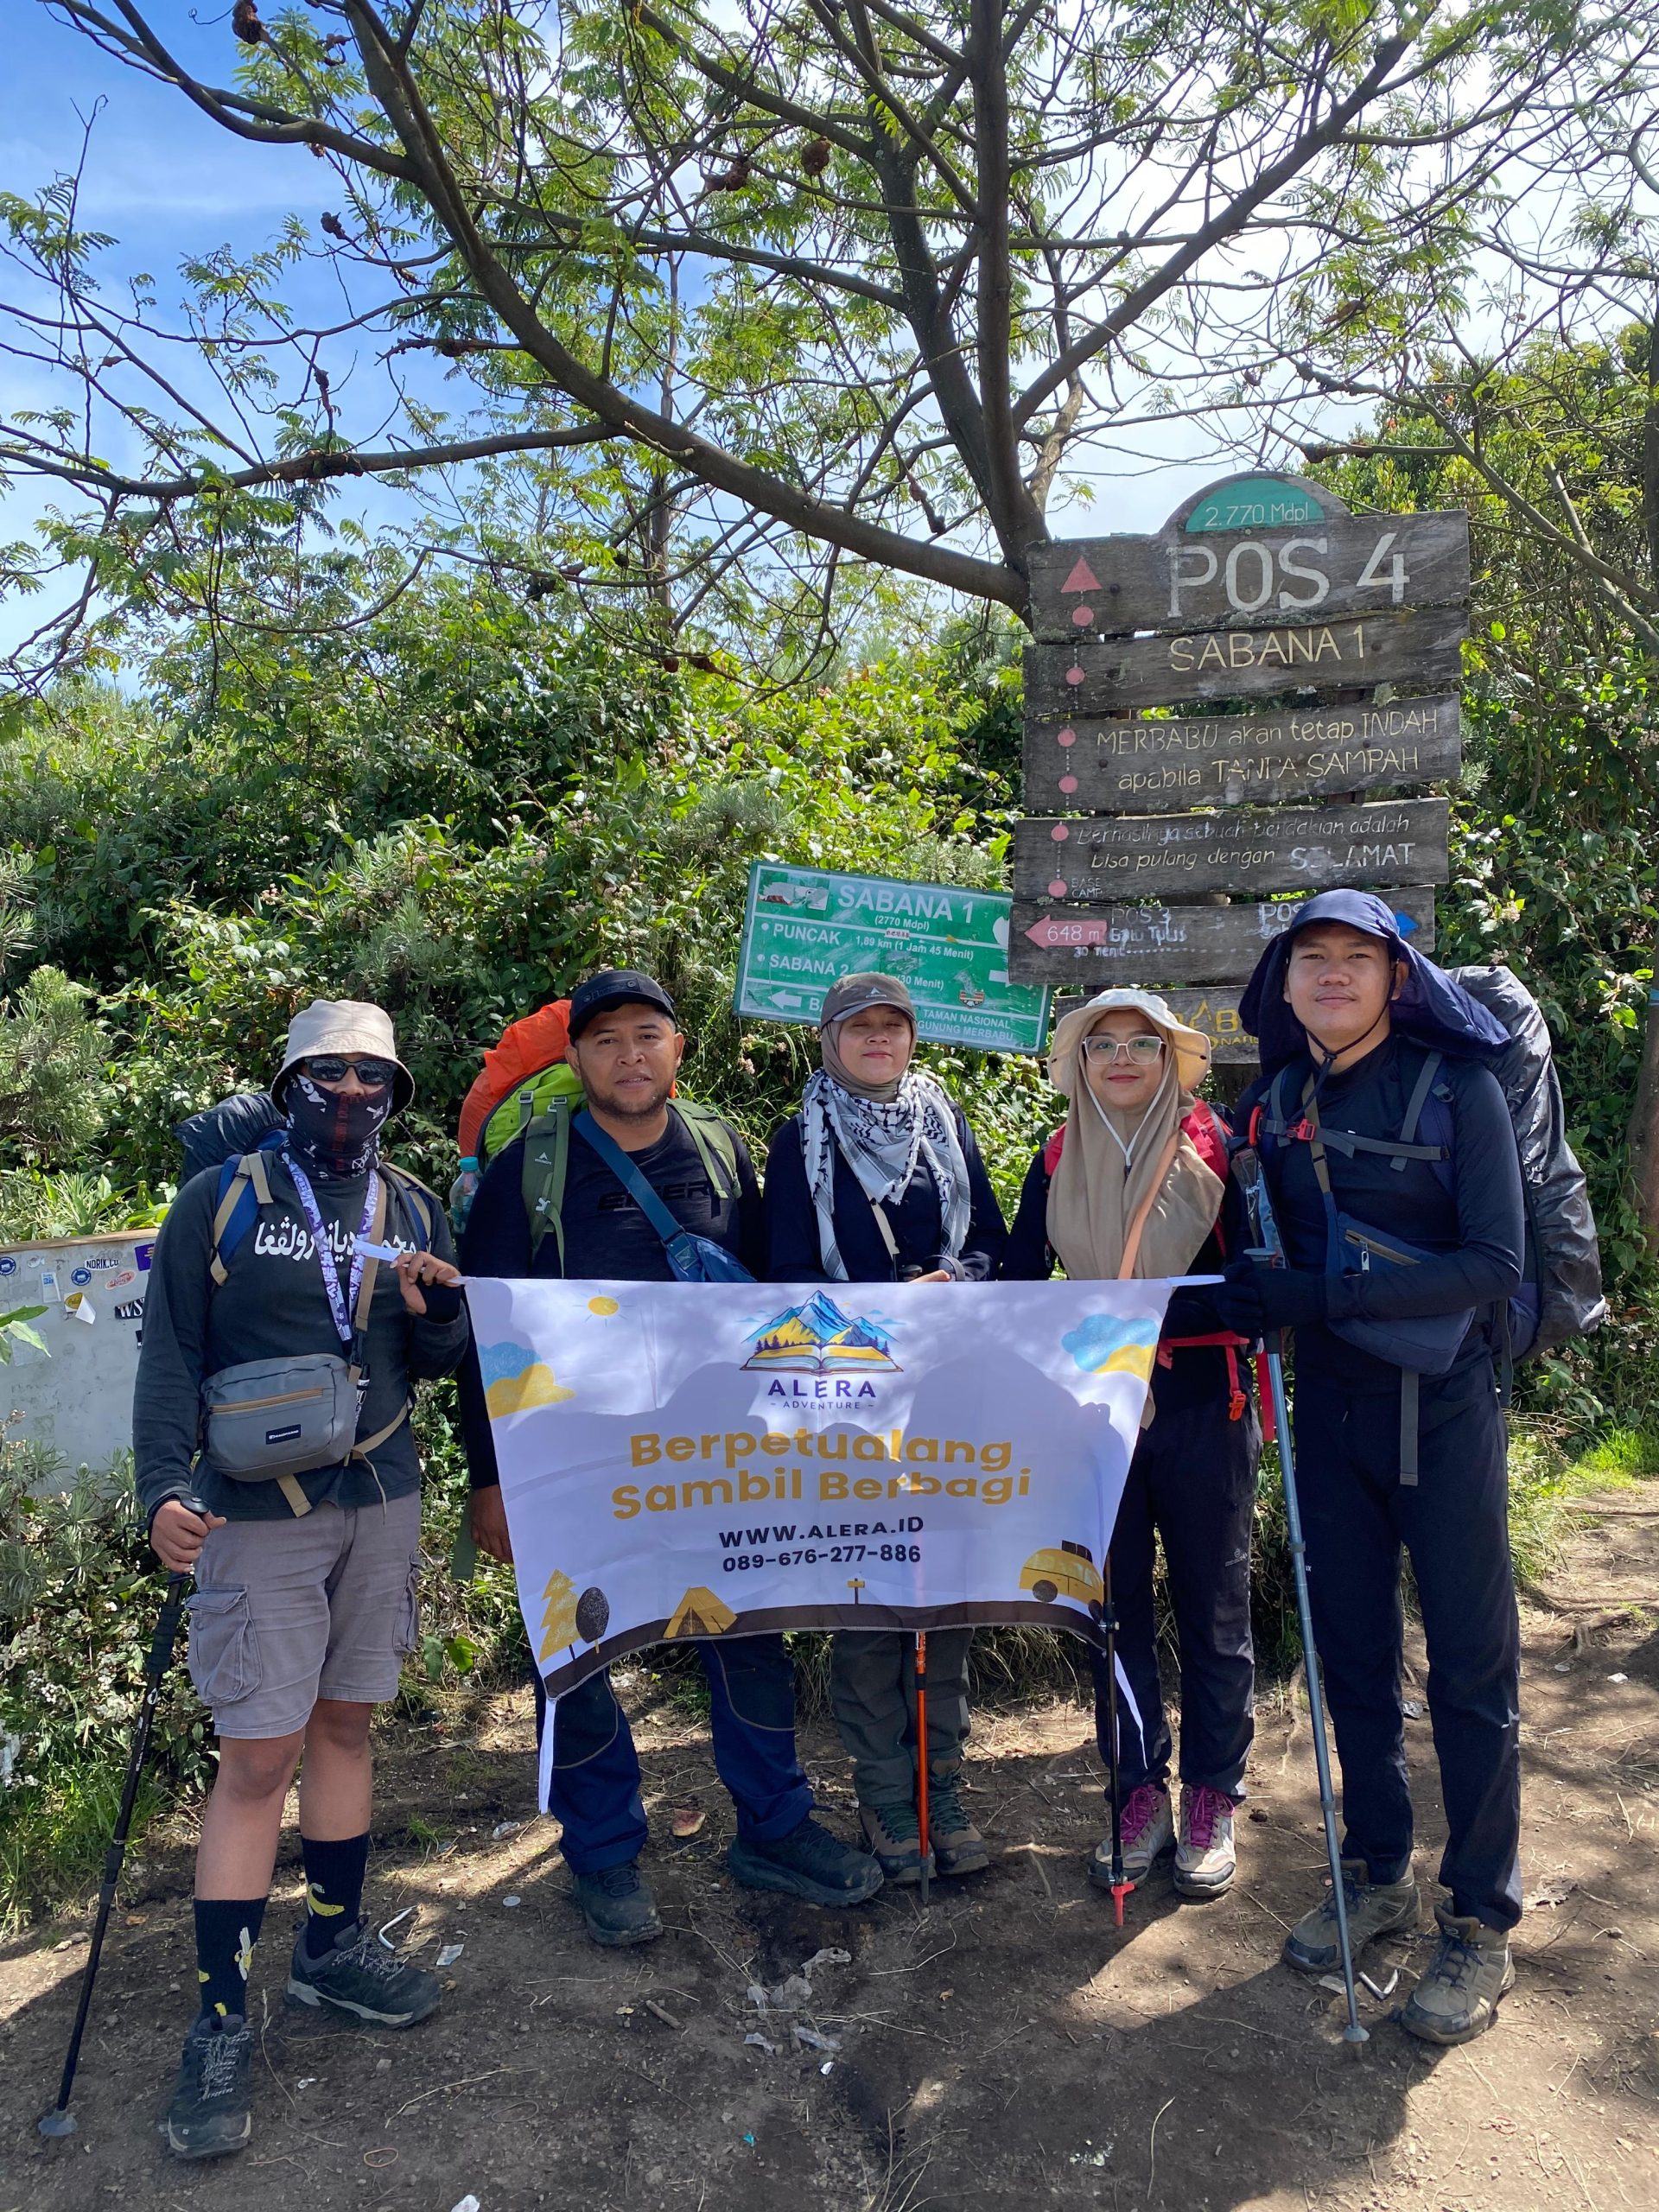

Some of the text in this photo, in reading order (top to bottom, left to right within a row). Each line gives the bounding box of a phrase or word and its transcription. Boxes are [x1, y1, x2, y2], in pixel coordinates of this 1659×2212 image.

[1205, 502, 1308, 526] 2.770 Mdpl
[1166, 532, 1410, 618] POS 4
[1169, 624, 1364, 672] SABANA 1
[1097, 709, 1437, 754] MERBABU akan tetap INDAH
[1119, 764, 1201, 793] apabila
[1306, 747, 1419, 778] SAMPAH
[1350, 814, 1409, 835] adalah
[1135, 849, 1198, 872] pulang
[1207, 848, 1275, 870] dengan
[1071, 878, 1101, 888] BASE
[1071, 887, 1103, 898] CAMP
[838, 885, 974, 924] SABANA 1
[773, 924, 842, 944] PUNCAK
[874, 915, 930, 932] (2770 Mdpl)
[1047, 925, 1100, 942] 648 m
[877, 938, 892, 949] km
[906, 942, 927, 954] Jam
[929, 945, 942, 956] 45
[944, 947, 974, 961] Menit)
[769, 954, 836, 976] SABANA
[839, 964, 849, 976] 2
[914, 976, 944, 991] Menit)
[923, 1008, 1011, 1029] TAMAN NASIONAL
[917, 1020, 1014, 1040] GUNUNG MERBABU
[768, 1379, 876, 1399] ALERA
[783, 1401, 861, 1410] ADVENTURE
[631, 1427, 1012, 1472] Berpetualang
[612, 1467, 1032, 1519] Sambil Berbagi
[719, 1516, 924, 1548] WWW.ALERA.ID
[722, 1544, 921, 1573] 089-676-277-886
